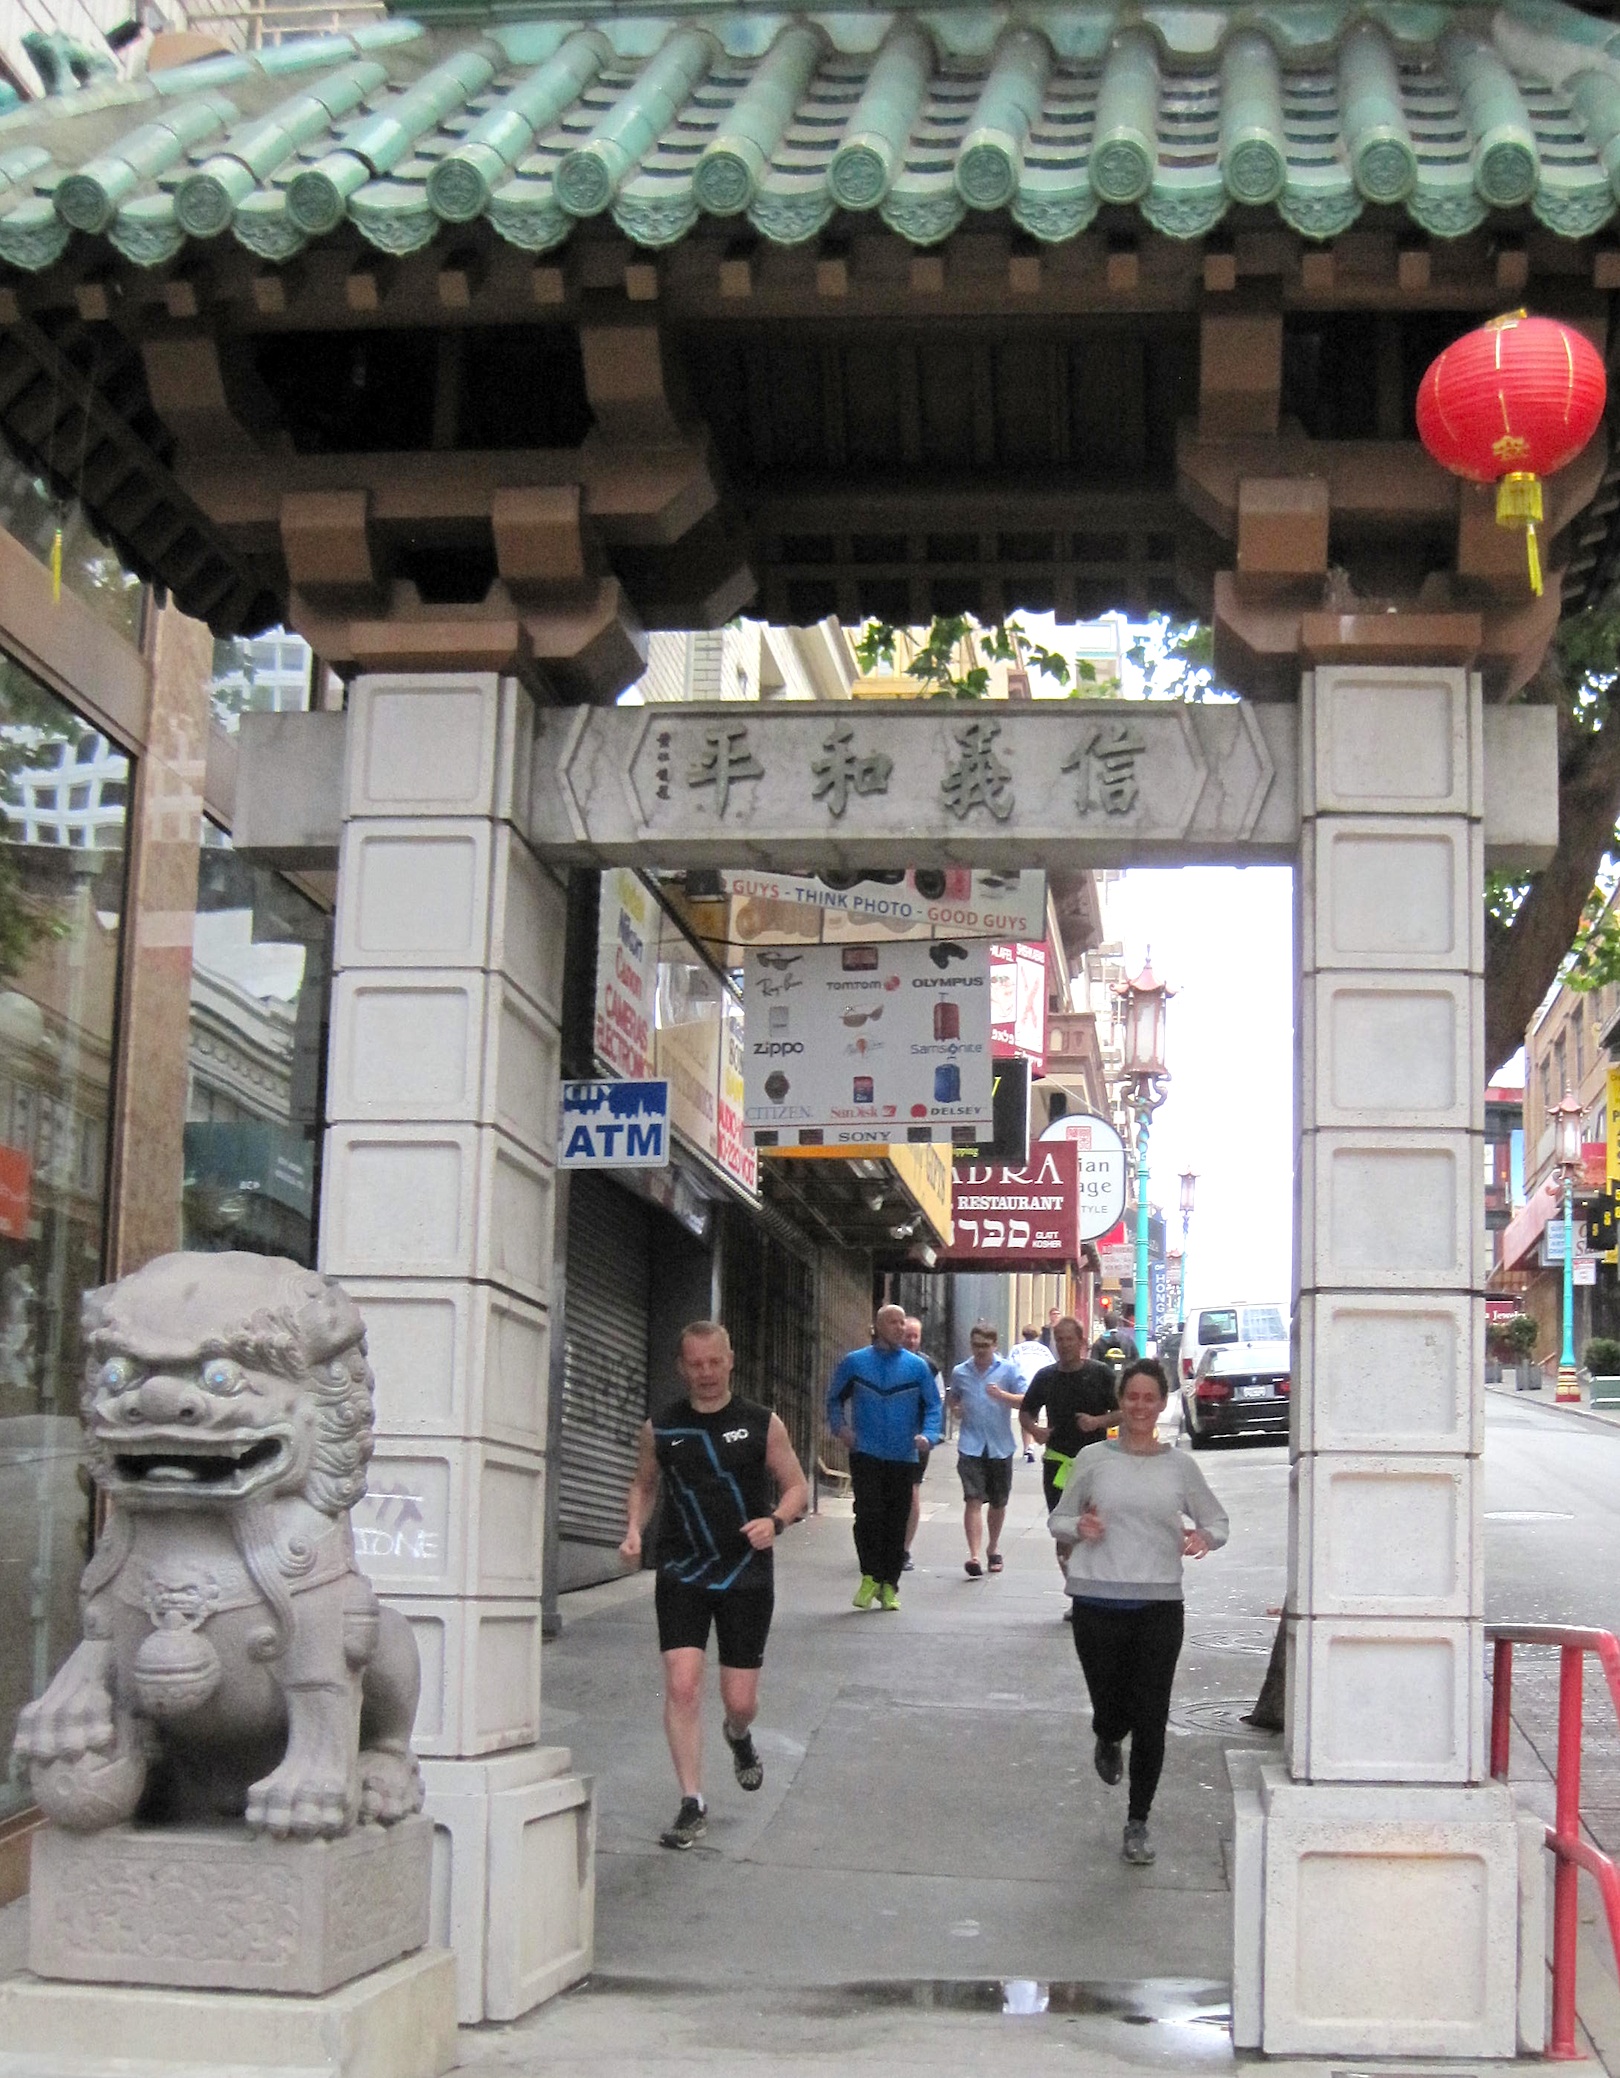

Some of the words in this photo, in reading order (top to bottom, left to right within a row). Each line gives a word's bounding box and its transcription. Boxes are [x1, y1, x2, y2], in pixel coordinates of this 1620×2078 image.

[733, 879, 779, 898] GUYS
[795, 887, 848, 908] THINK
[853, 896, 912, 917] PHOTO
[928, 907, 979, 926] GOOD
[983, 912, 1028, 931] GUYS
[912, 976, 984, 988] OLYMPUS
[565, 1085, 612, 1101] CITY
[745, 1105, 811, 1121] CITIZEN
[930, 1106, 982, 1116] DELSEY
[564, 1123, 662, 1158] ATM
[838, 1131, 892, 1143] SONY
[957, 1195, 1064, 1211] RESTAURANT
[1155, 1273, 1166, 1313] HONG
[722, 1429, 749, 1443] T90
